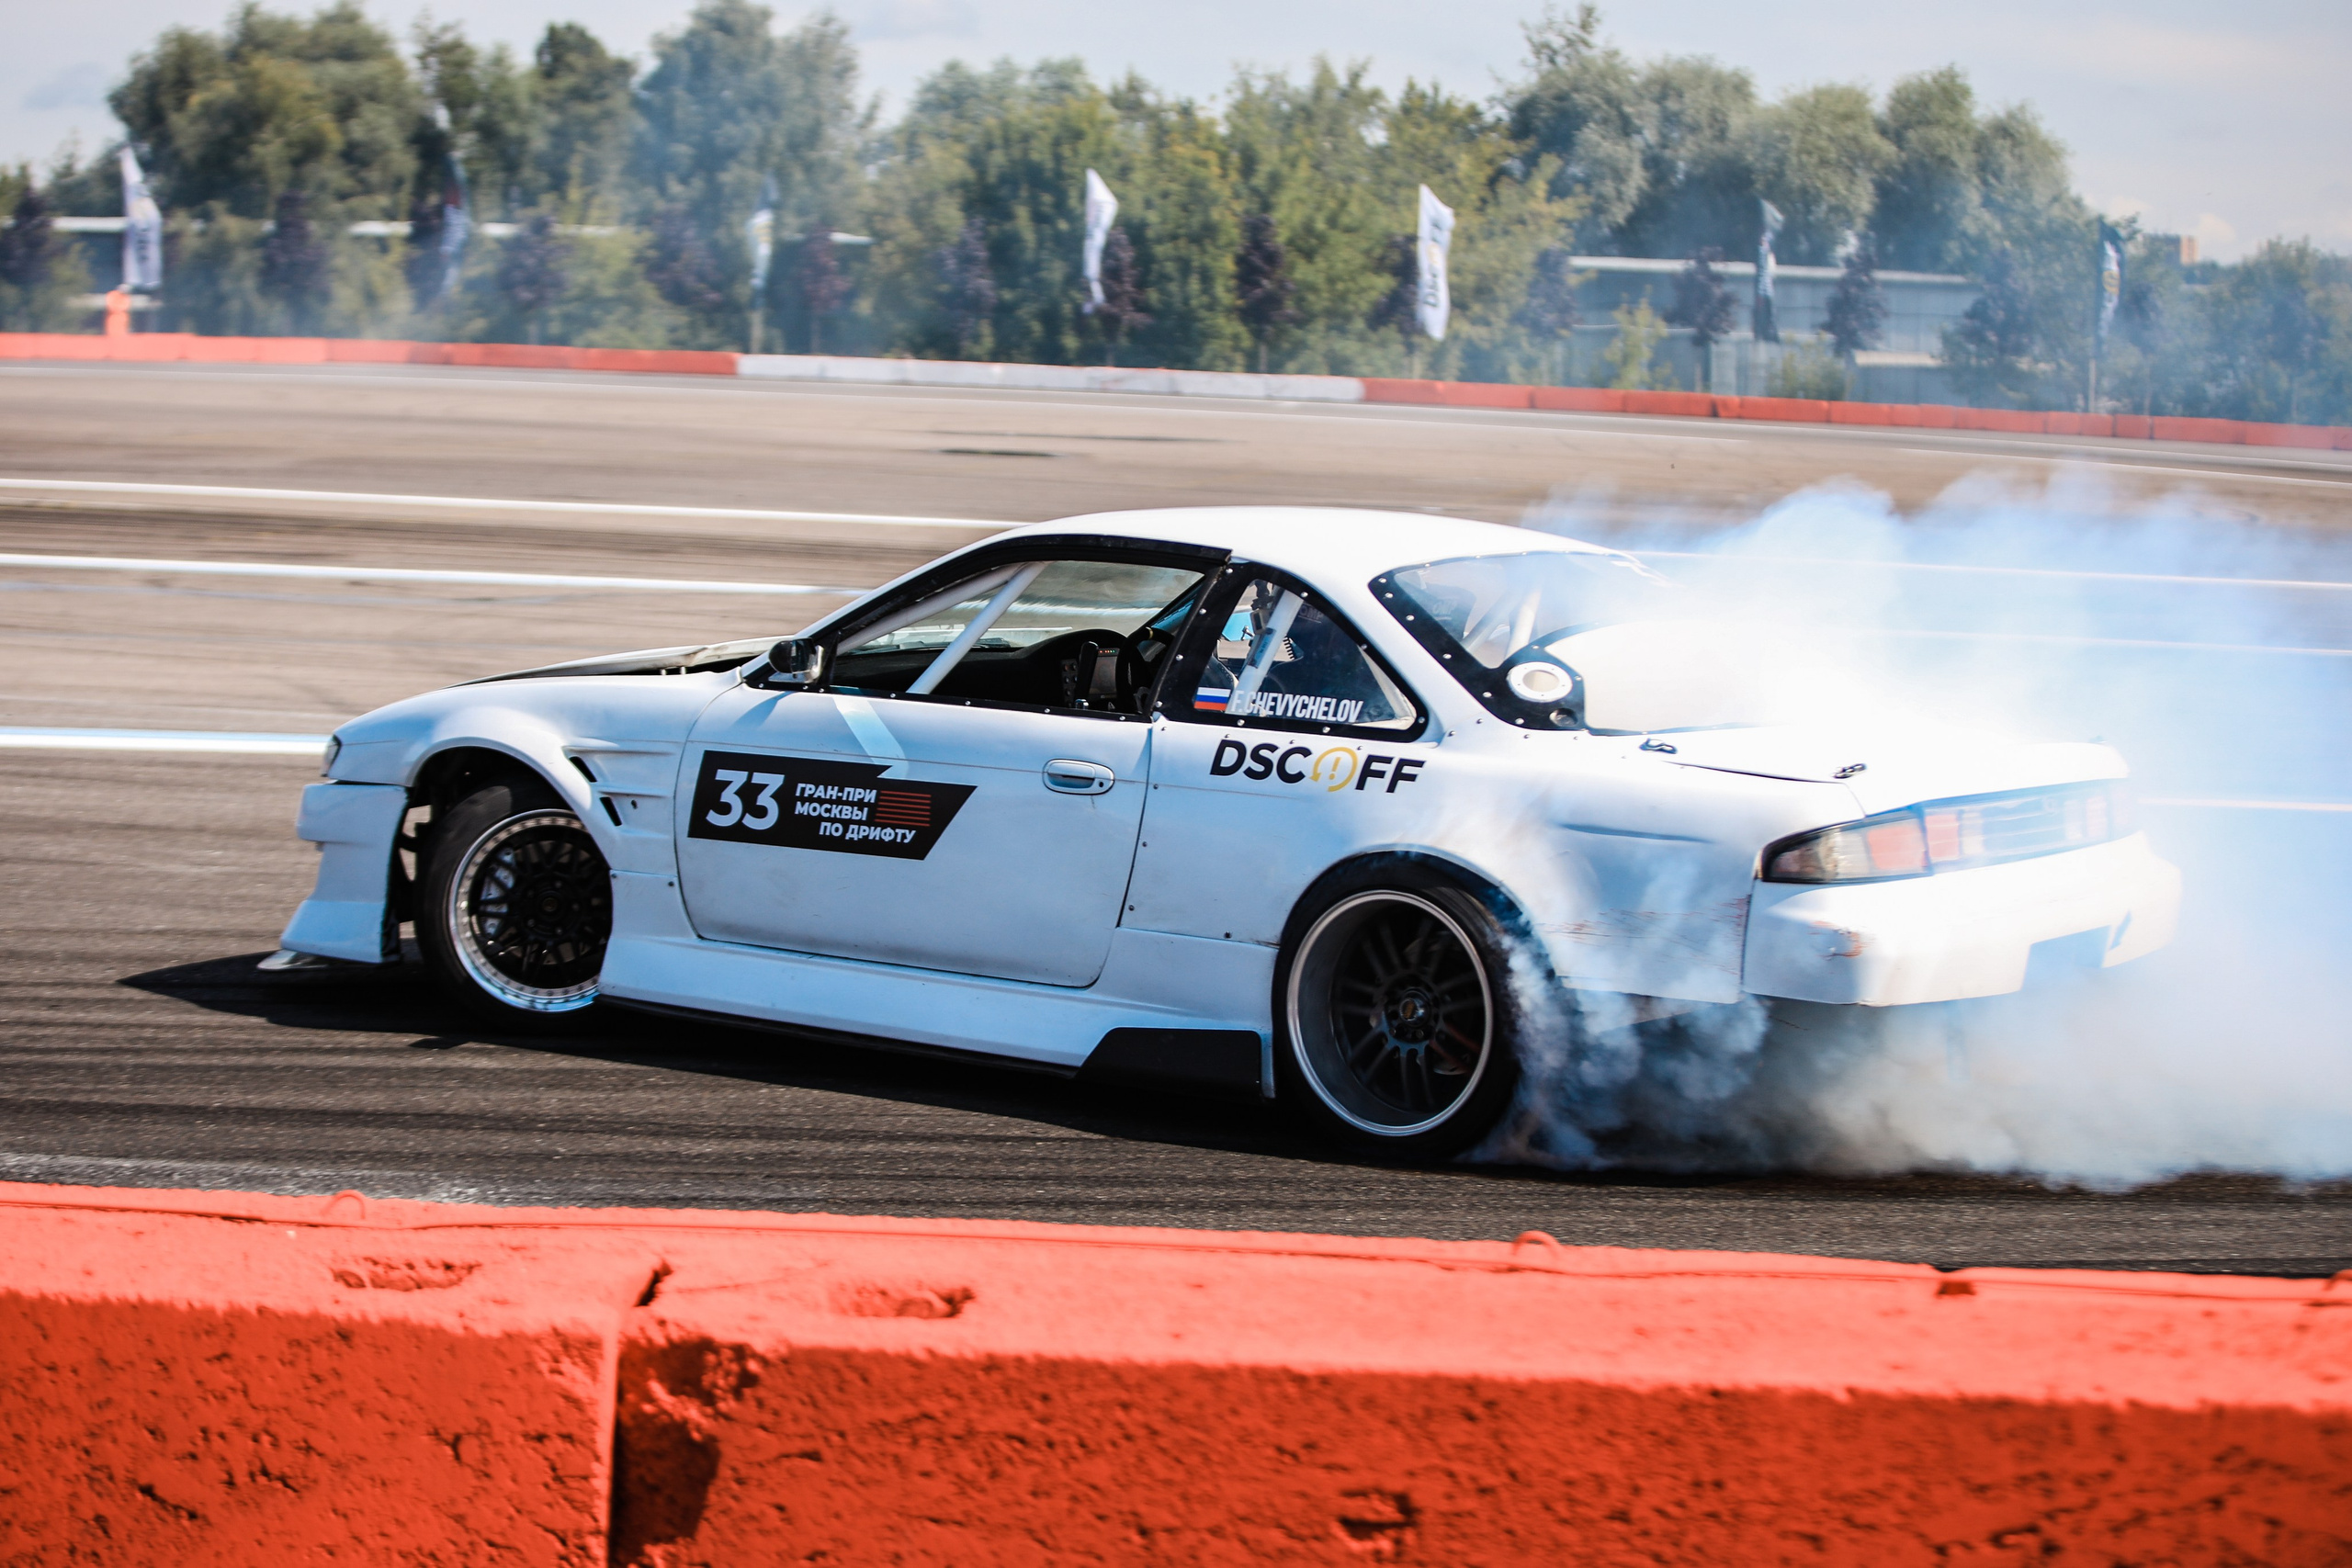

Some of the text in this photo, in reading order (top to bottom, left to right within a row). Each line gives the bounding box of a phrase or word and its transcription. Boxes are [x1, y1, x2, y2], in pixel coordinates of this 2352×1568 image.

[706, 769, 786, 830] 33
[796, 783, 877, 803] ГРАН-ПРИ
[795, 802, 868, 821] МОСКВЫ
[819, 821, 916, 844] ПО ДРИФТУ
